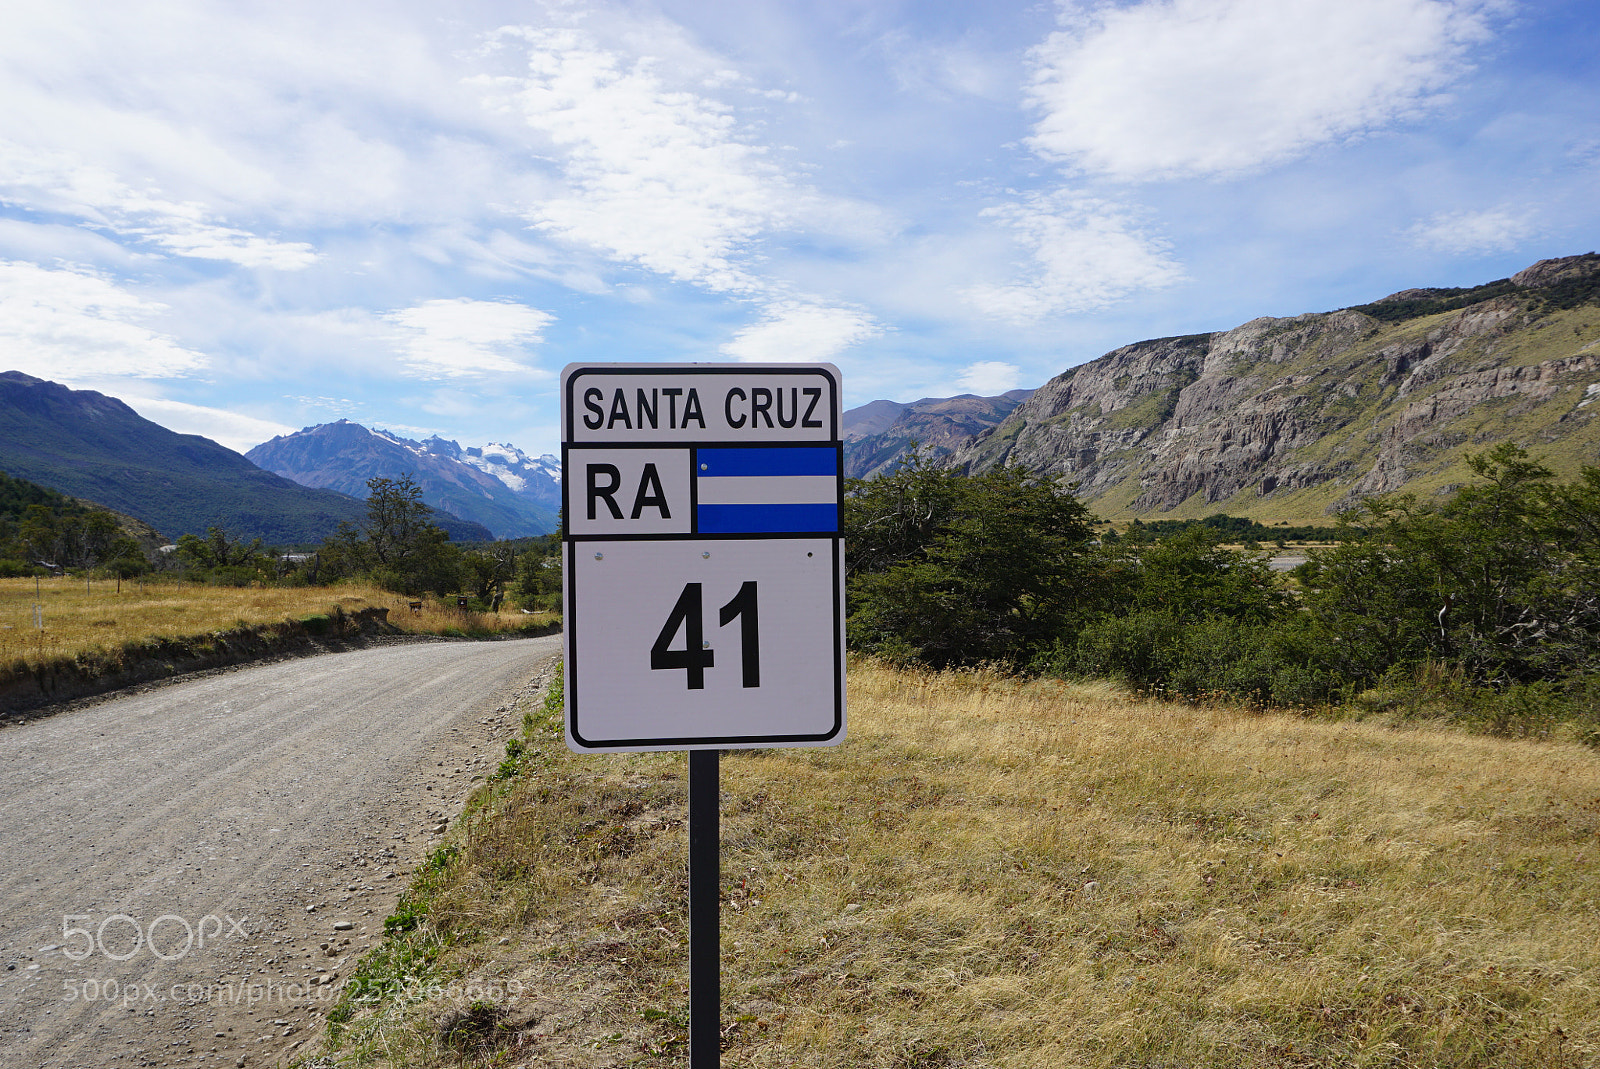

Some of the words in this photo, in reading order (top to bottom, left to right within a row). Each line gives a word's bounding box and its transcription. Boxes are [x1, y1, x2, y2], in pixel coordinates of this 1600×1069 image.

[583, 388, 706, 430] SANTA
[724, 387, 823, 429] CRUZ
[586, 463, 672, 520] RA
[650, 581, 760, 690] 41
